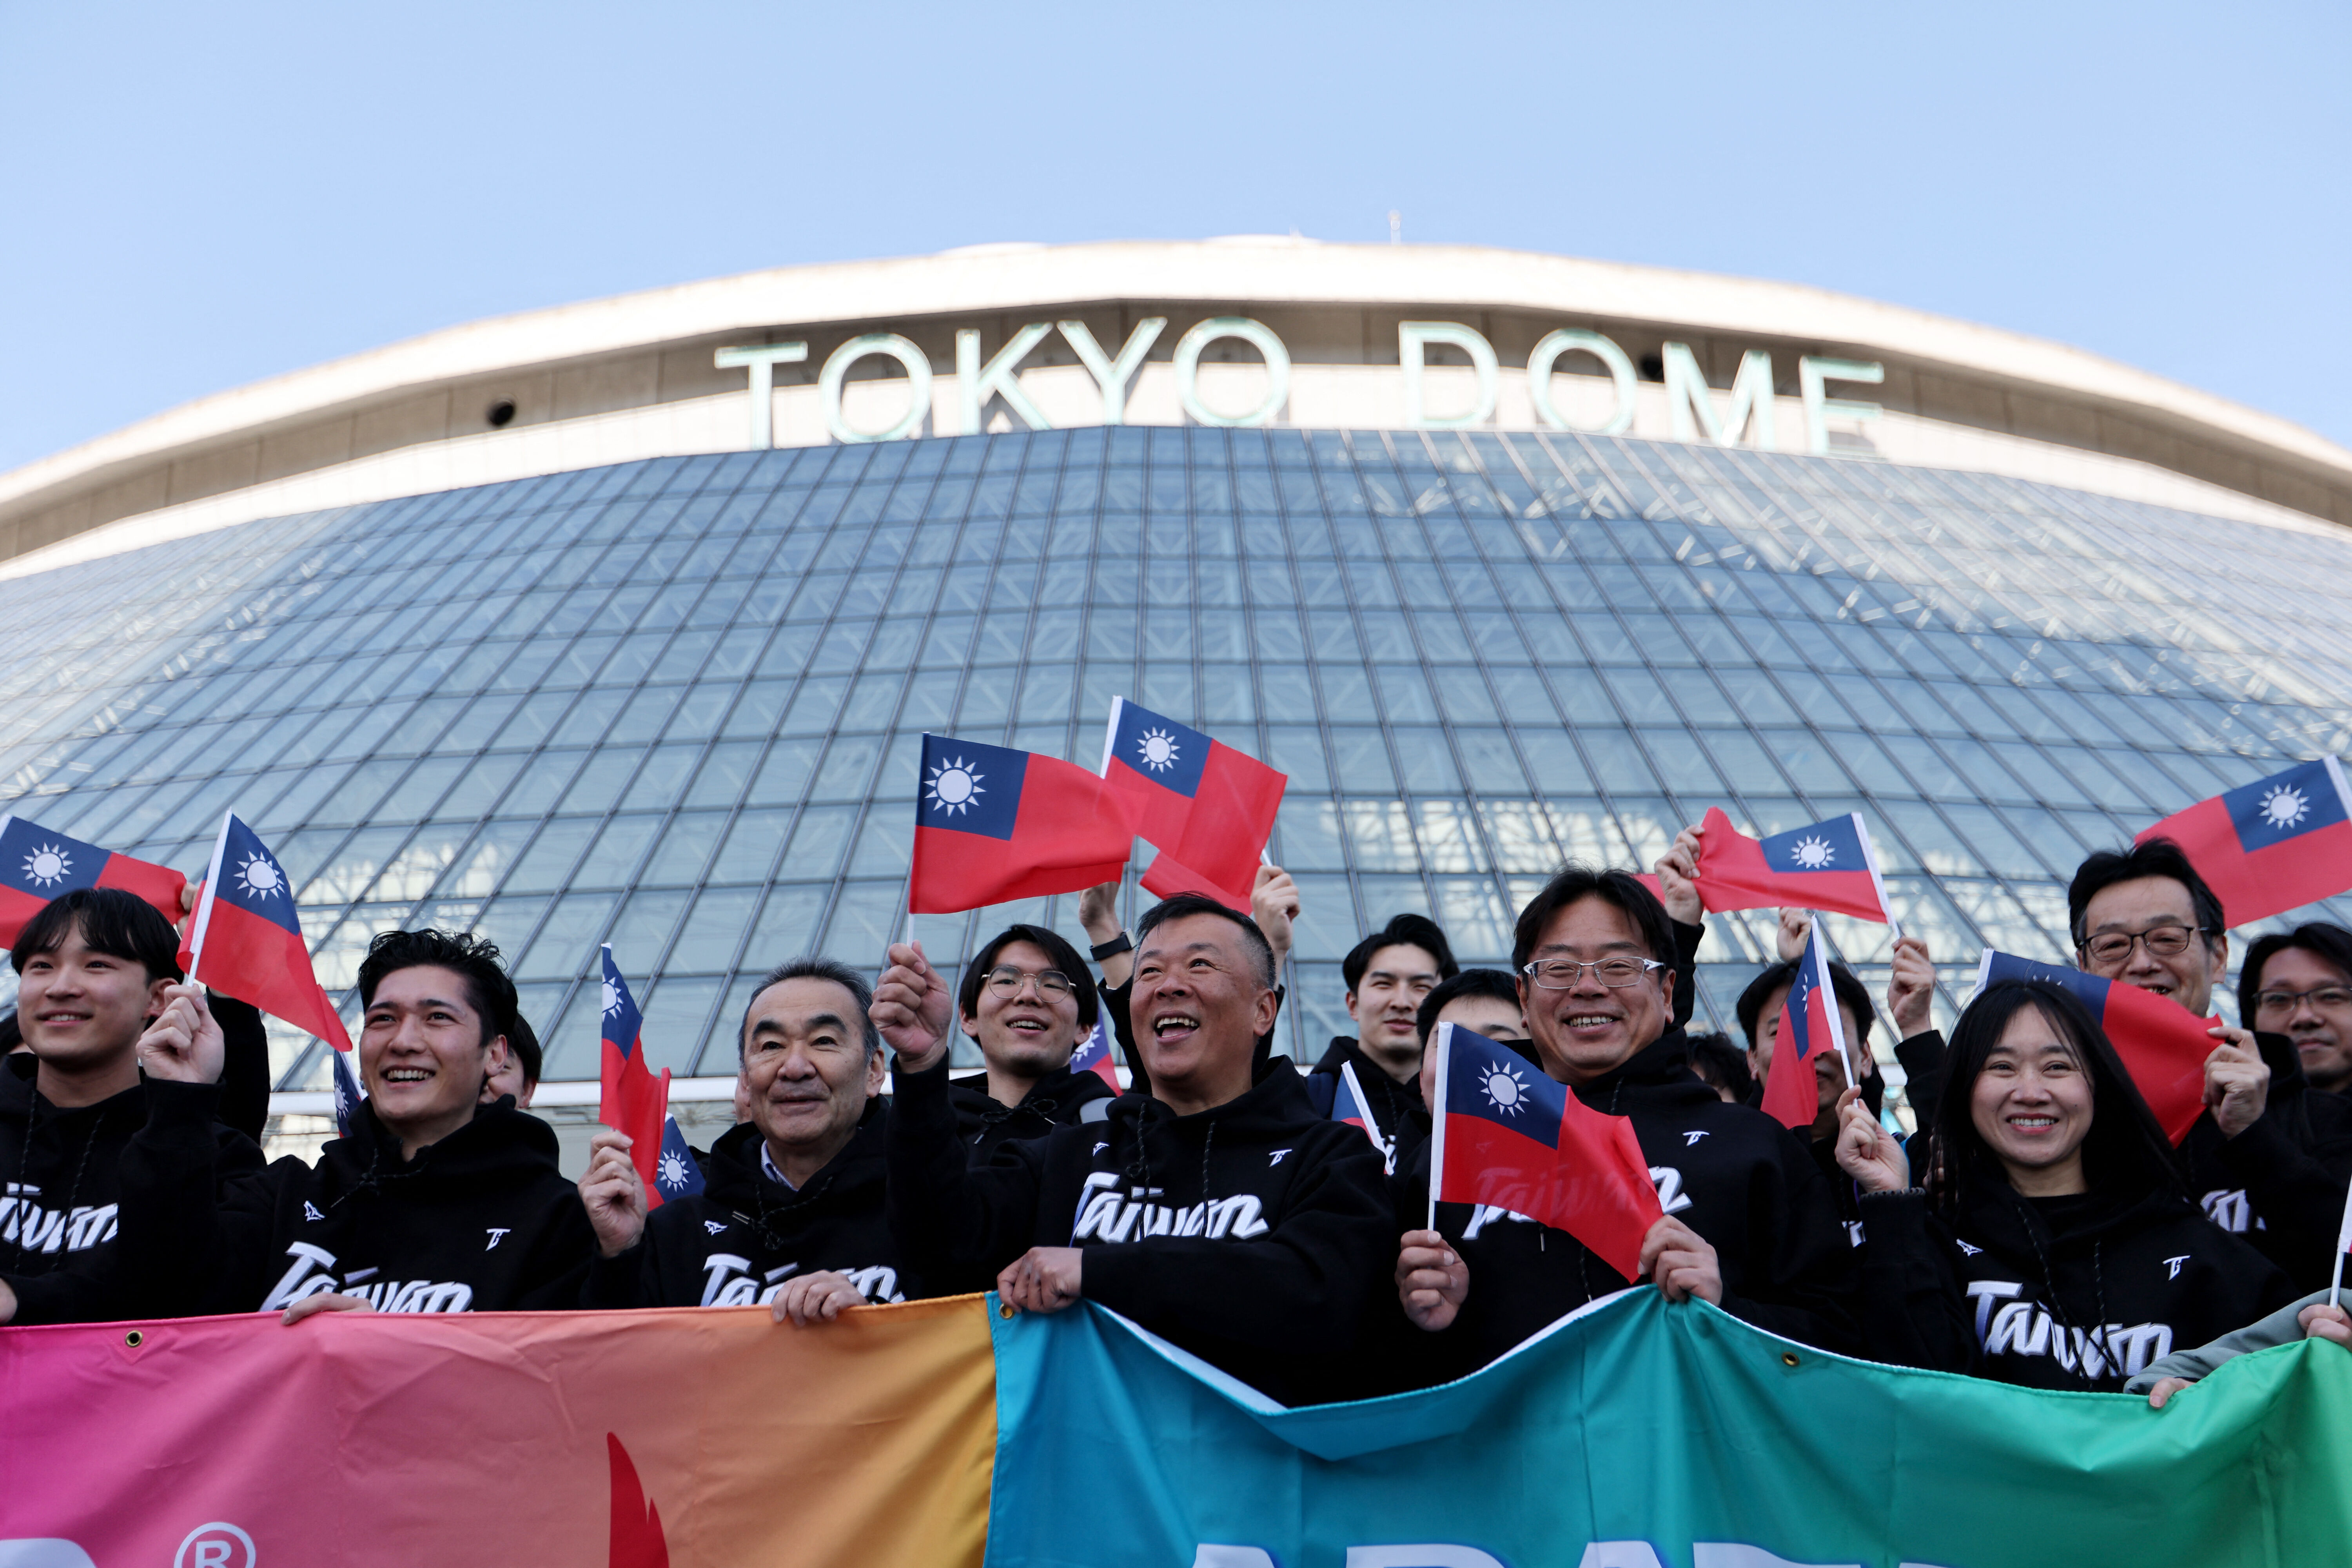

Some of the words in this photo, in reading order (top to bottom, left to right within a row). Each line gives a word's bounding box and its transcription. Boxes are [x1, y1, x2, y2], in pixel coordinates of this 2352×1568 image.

[714, 316, 1291, 451] TOKYO
[1398, 321, 1885, 457] DOME
[1069, 1172, 1270, 1248] Taiwan
